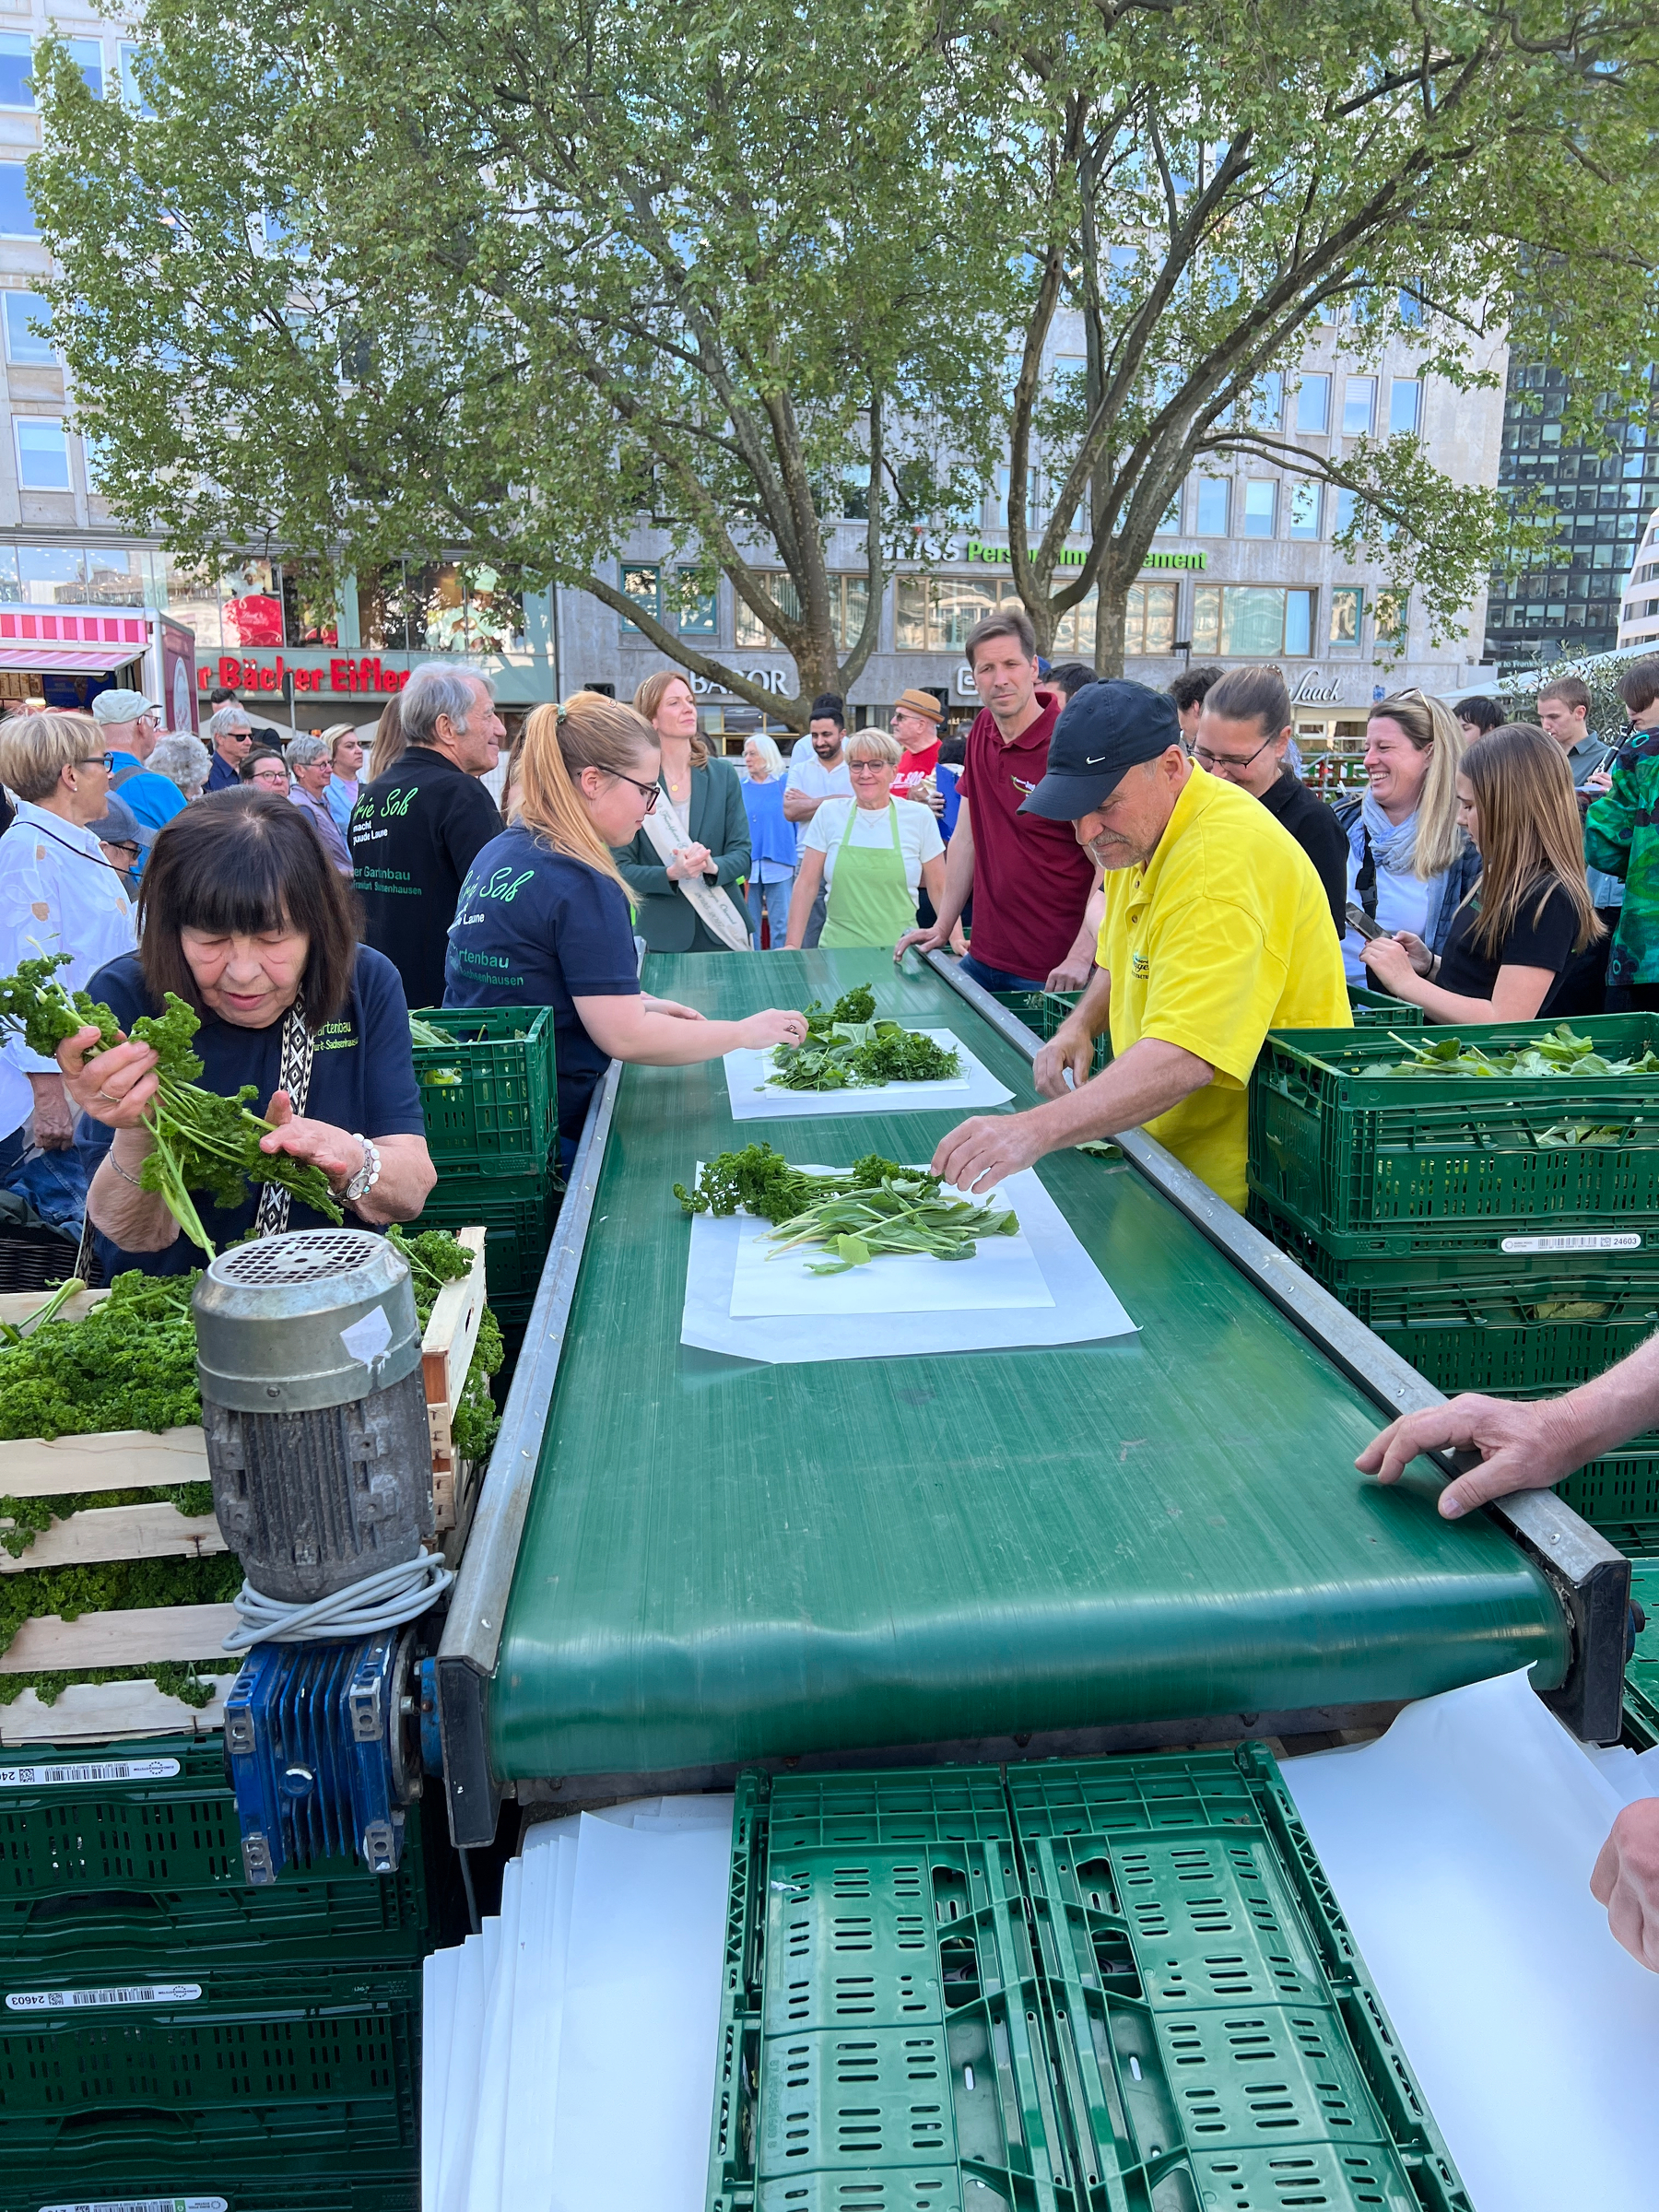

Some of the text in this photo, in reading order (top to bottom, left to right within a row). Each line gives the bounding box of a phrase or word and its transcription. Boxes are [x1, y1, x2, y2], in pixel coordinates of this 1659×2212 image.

[689, 669, 790, 696] BAOR
[458, 948, 510, 969] rtenbau
[316, 1019, 351, 1037] artenbau
[0, 1771, 16, 1782] 24
[11, 1995, 45, 2006] 24603
